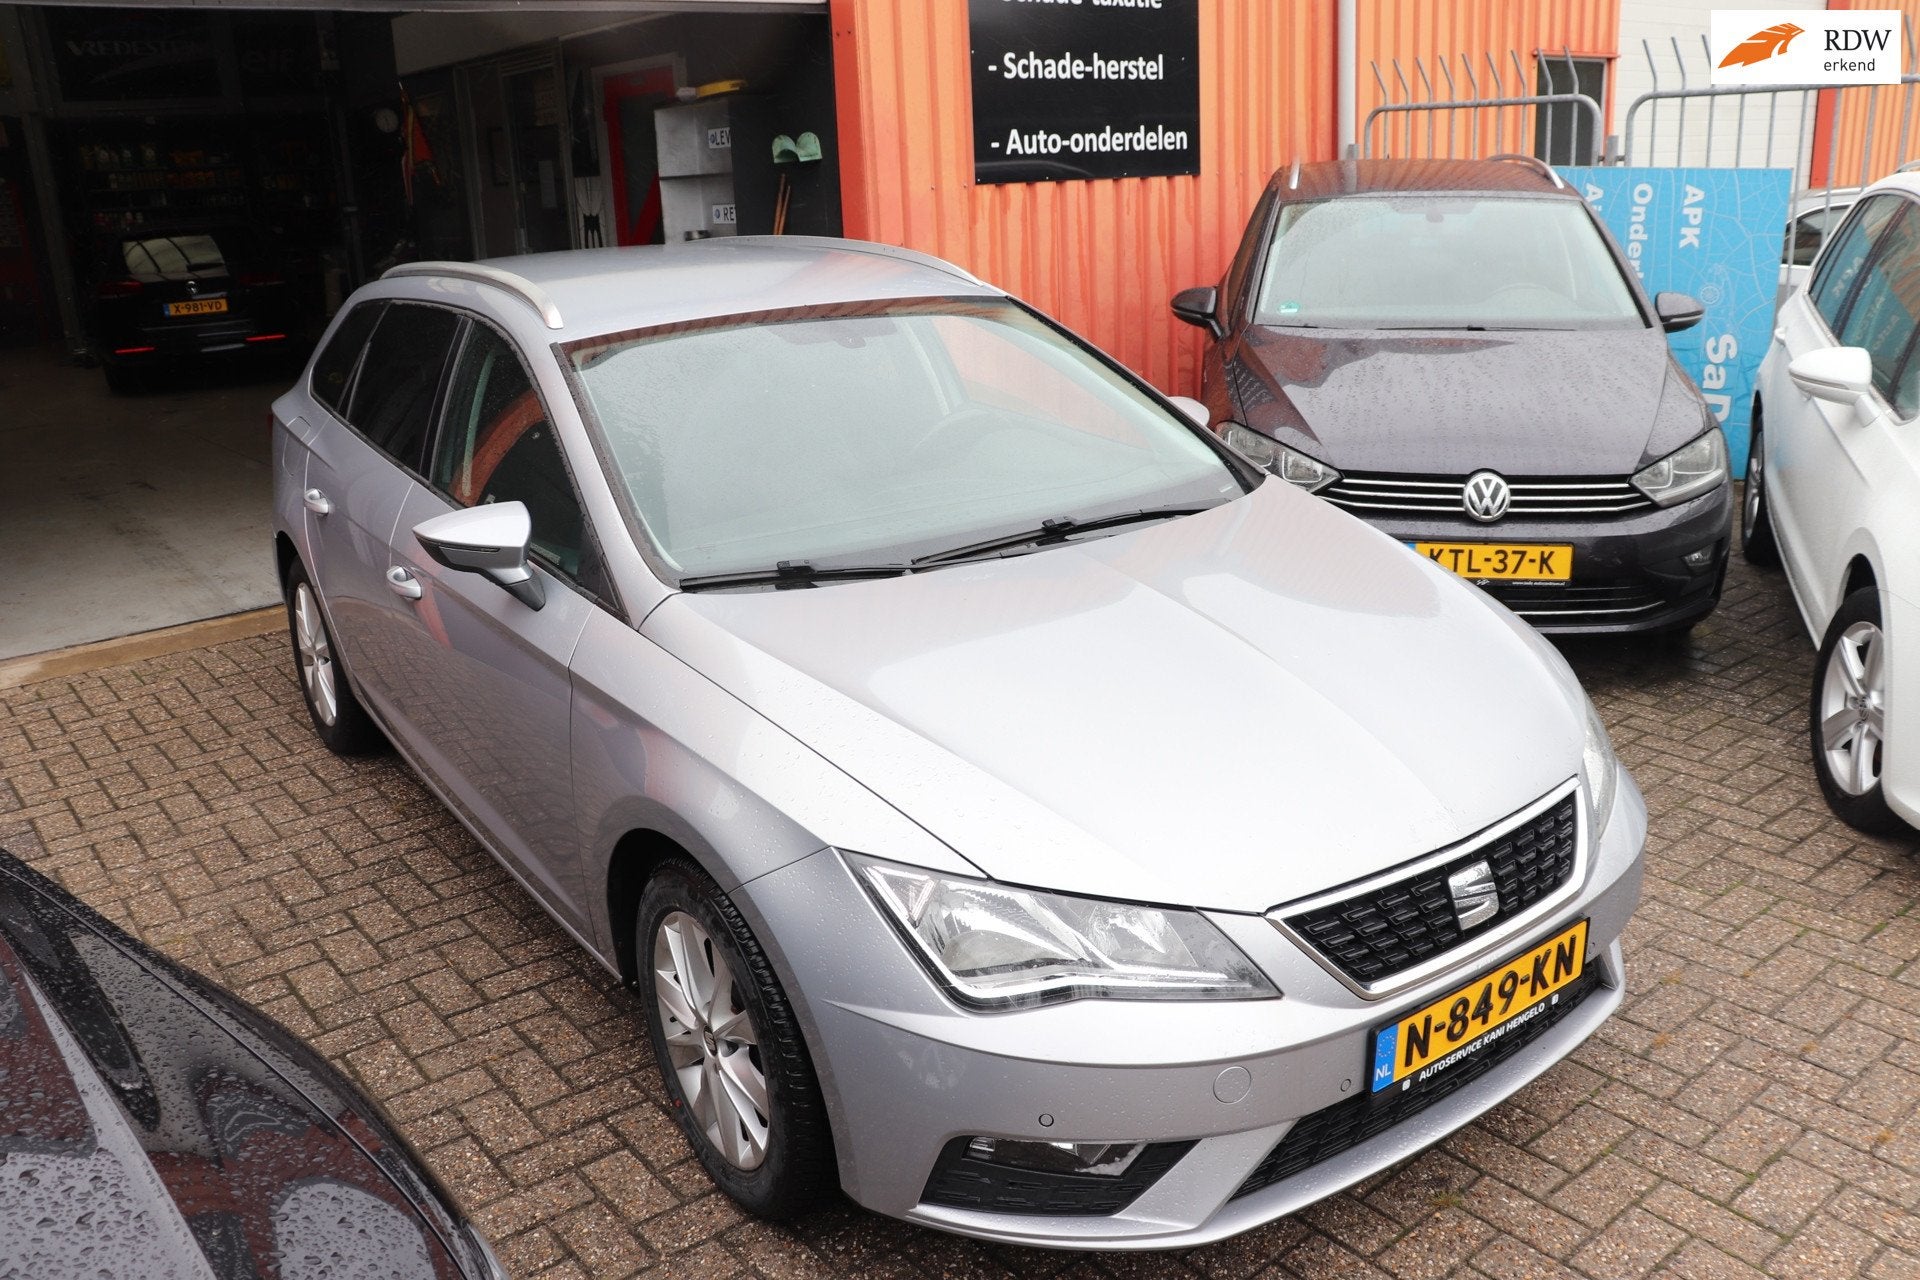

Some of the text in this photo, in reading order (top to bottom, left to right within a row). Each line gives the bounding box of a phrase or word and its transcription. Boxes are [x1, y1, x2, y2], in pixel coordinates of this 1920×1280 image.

[1003, 51, 1164, 80] Schade-herstel
[1006, 124, 1188, 155] Auto-onderdelen
[723, 206, 736, 222] RE
[1679, 183, 1705, 249] APK
[1628, 183, 1653, 279] Onder
[174, 300, 222, 314] X-981-VD
[1404, 934, 1577, 1067] N-849-KN
[1419, 1002, 1545, 1081] AUTOSERVICE KANI HENGELO
[1375, 1063, 1391, 1081] NL
